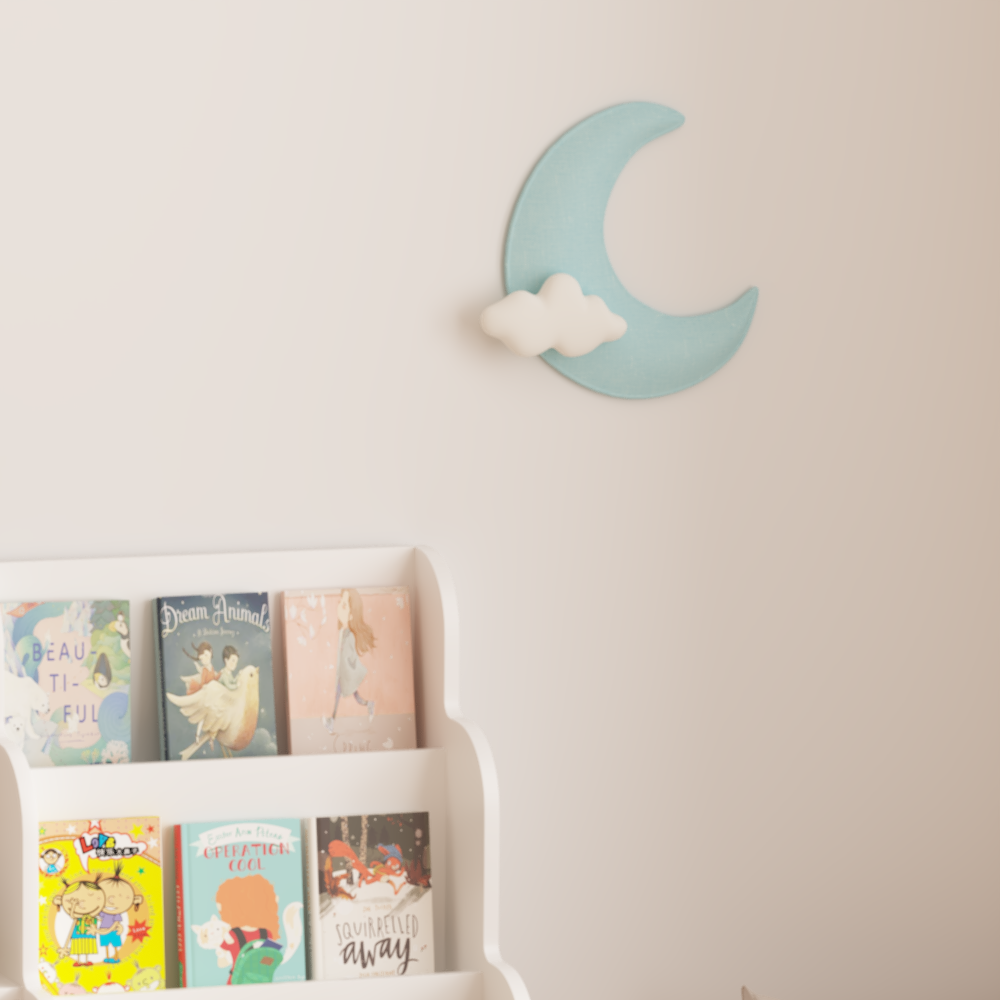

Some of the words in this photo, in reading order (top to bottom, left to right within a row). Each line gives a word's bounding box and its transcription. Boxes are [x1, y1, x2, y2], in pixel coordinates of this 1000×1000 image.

[160, 601, 209, 638] Dream
[212, 593, 271, 633] Animals
[49, 673, 80, 692] TI-
[63, 704, 98, 723] FUL
[203, 842, 290, 859] OPERATION
[228, 858, 266, 872] COOL
[335, 914, 419, 946] SQUIRRELLED
[339, 937, 419, 976] away
